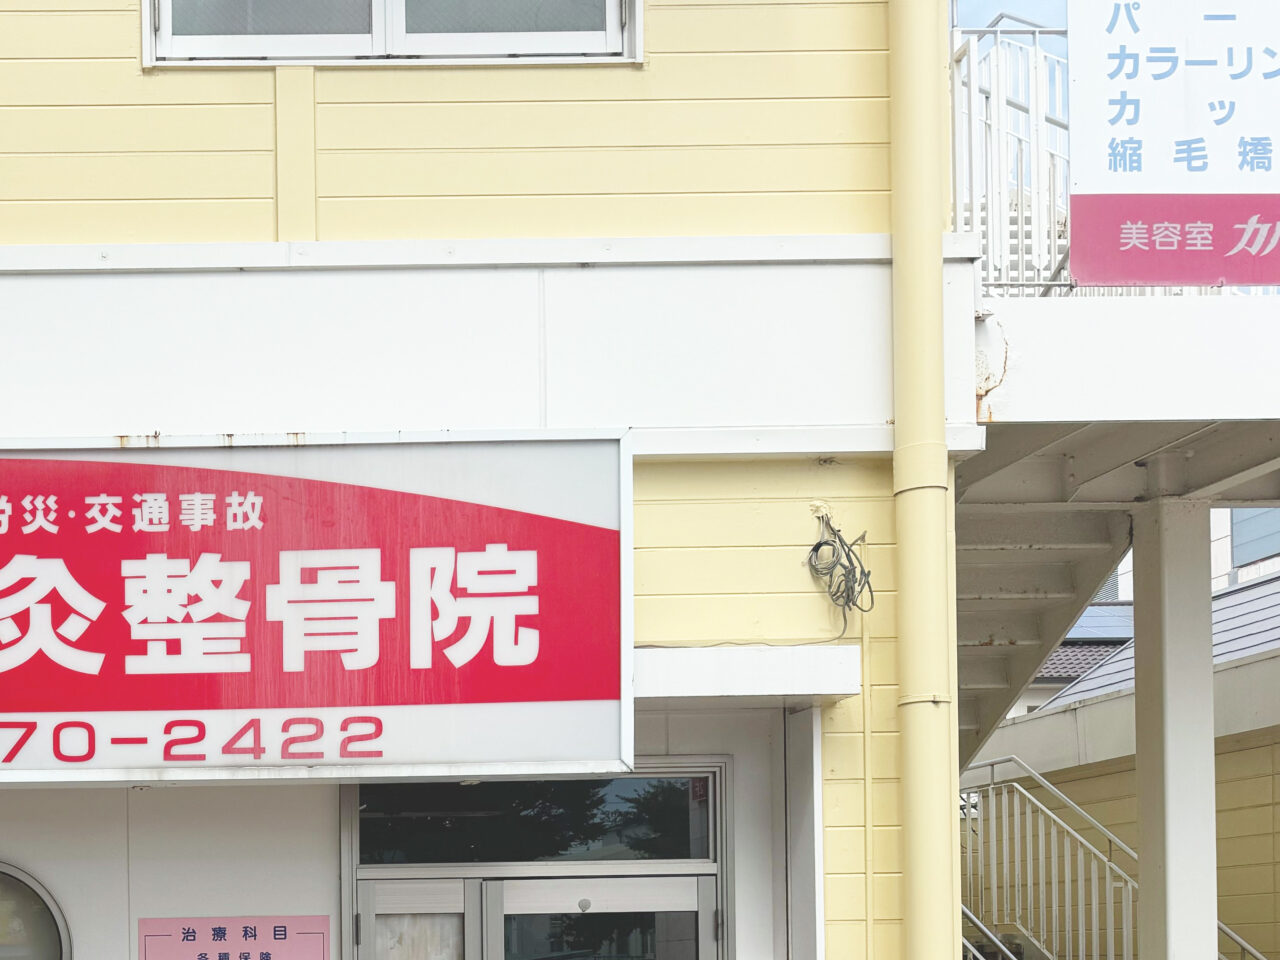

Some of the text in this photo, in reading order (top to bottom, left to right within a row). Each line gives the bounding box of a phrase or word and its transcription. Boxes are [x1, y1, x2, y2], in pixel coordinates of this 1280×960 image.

[1108, 136, 1273, 172] 縮毛矯
[1119, 220, 1214, 250] 美容室
[181, 925, 287, 942] 治療科目
